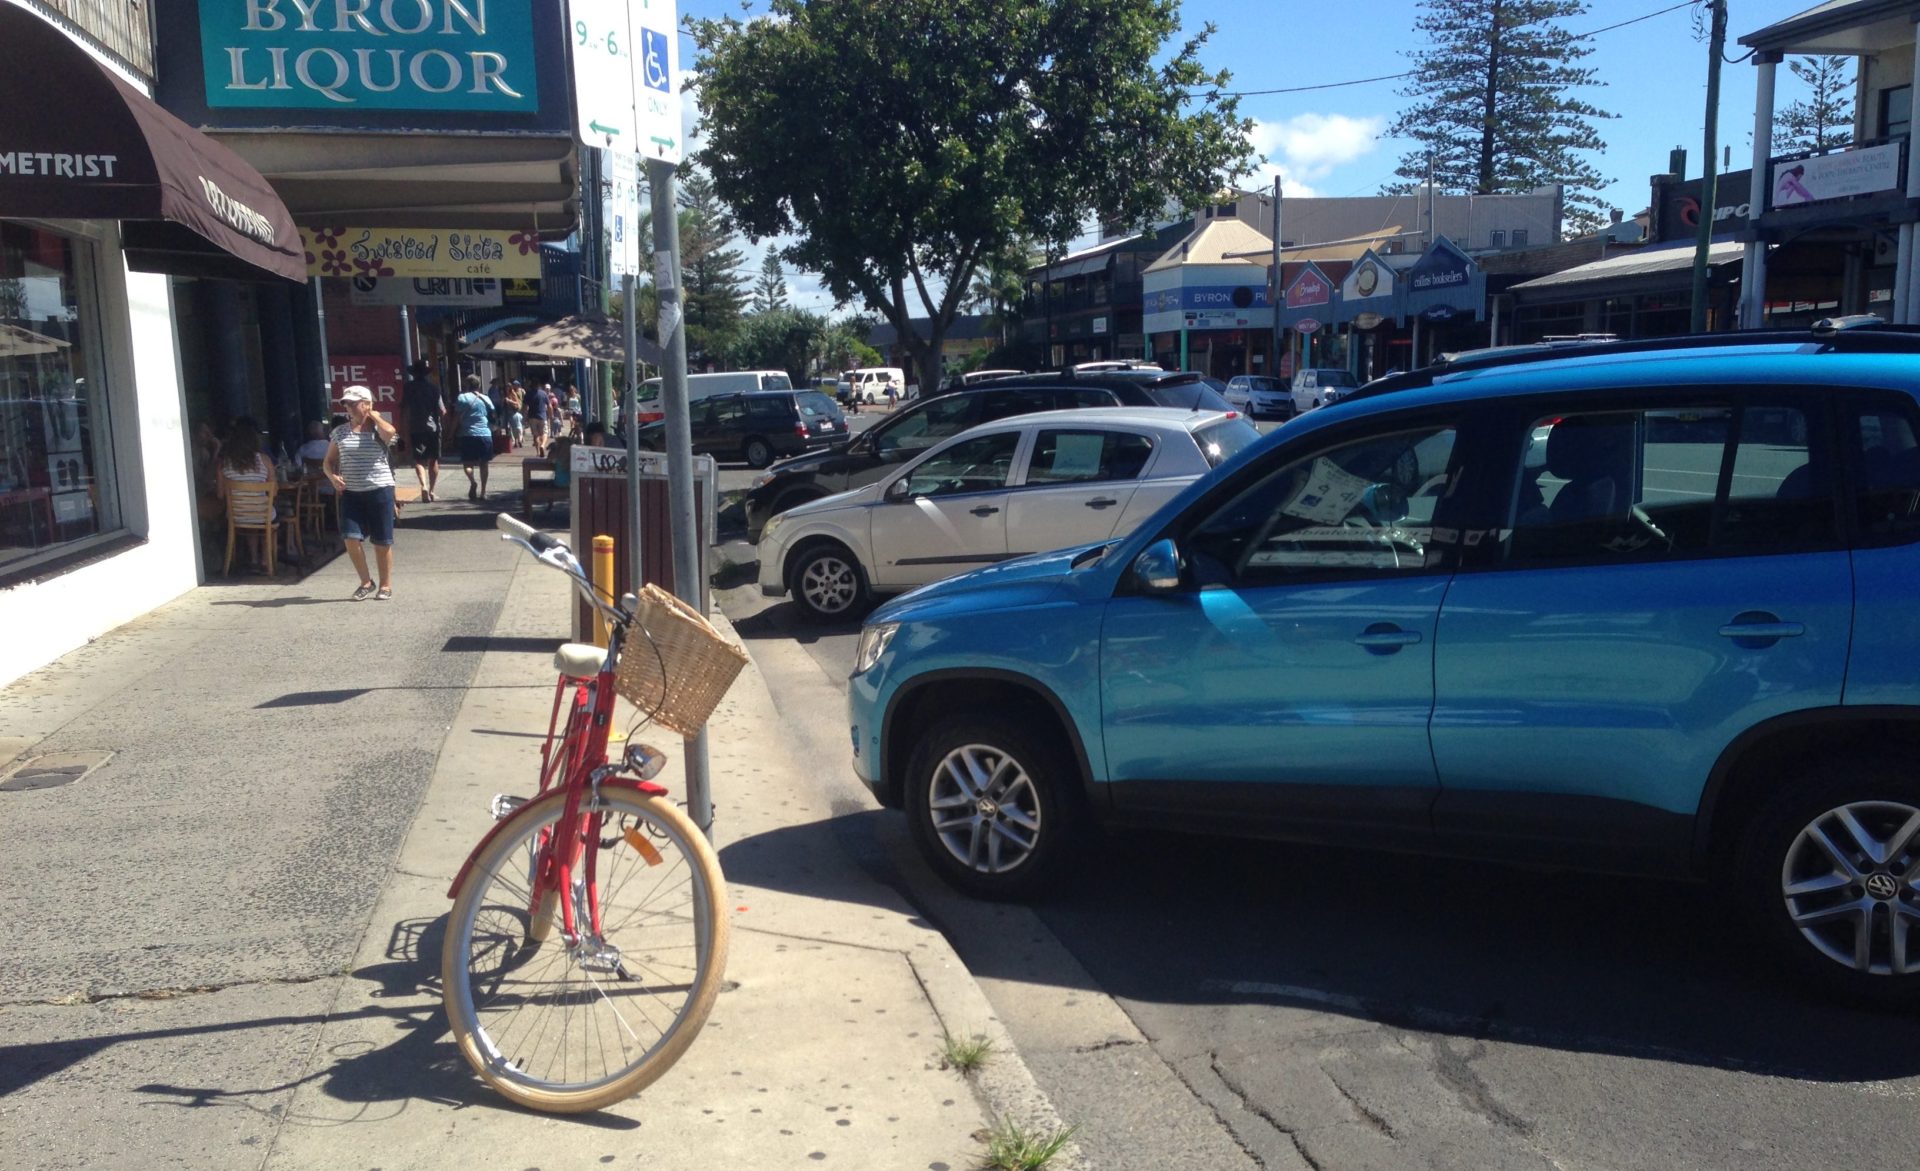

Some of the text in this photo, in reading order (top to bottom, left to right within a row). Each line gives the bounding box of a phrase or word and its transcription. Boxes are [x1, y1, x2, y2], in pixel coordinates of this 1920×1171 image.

[241, 0, 486, 36] BYRON
[224, 47, 525, 102] LIQUOR
[648, 96, 668, 115] ONLY
[0, 152, 117, 178] METRIST
[351, 230, 503, 261] Twisted Sista
[467, 263, 490, 274] café
[1194, 293, 1231, 303] BYRON
[331, 365, 367, 382] HE
